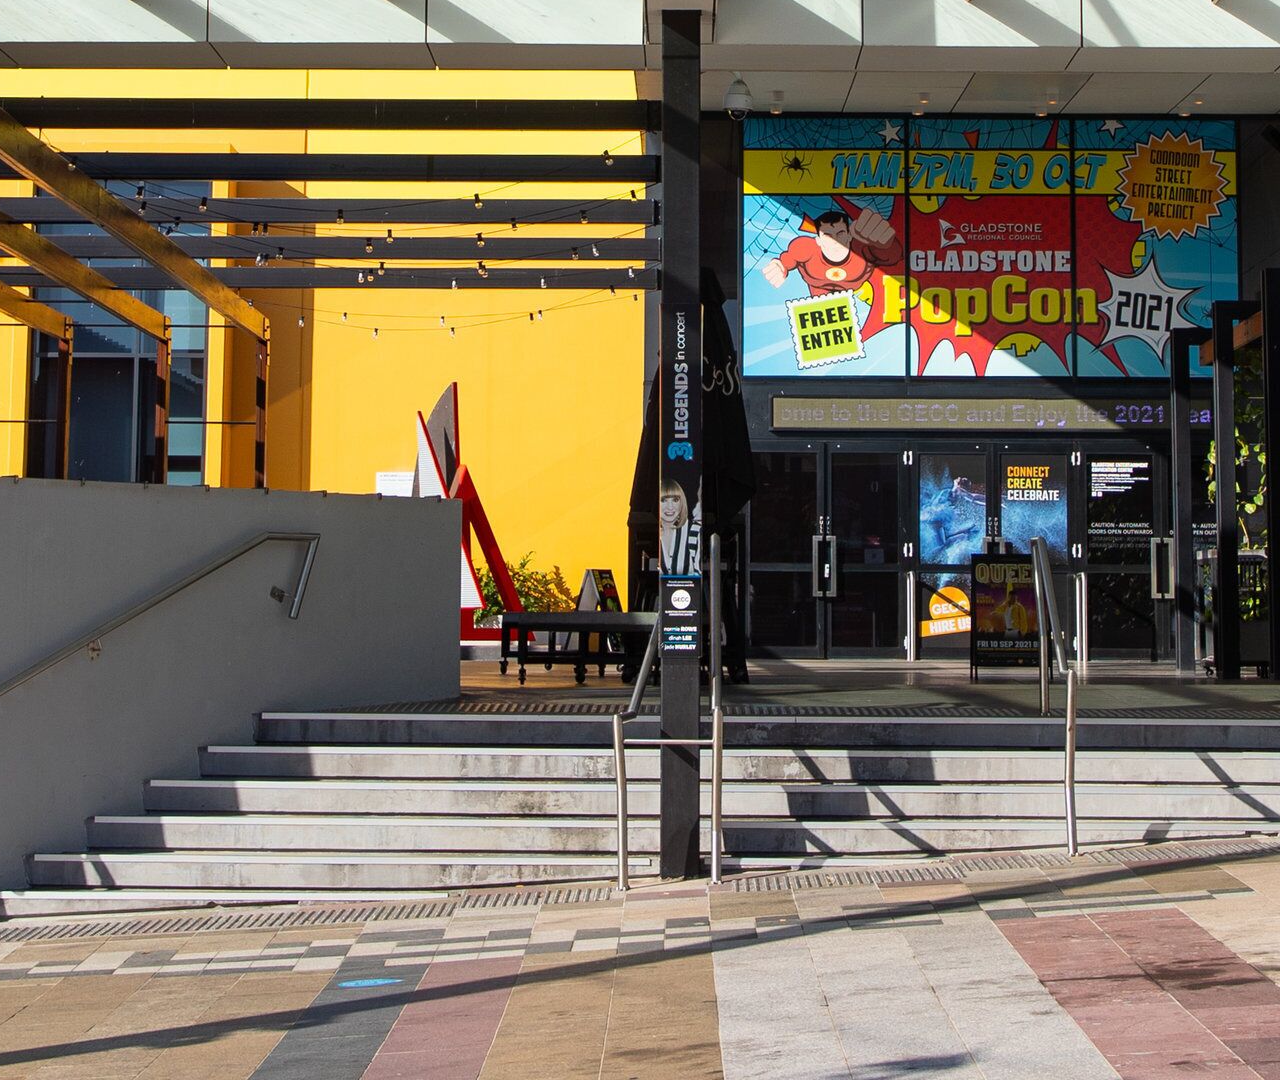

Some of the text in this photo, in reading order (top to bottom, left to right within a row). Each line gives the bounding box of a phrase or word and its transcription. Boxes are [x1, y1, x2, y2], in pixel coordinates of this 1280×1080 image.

[1150, 149, 1200, 168] GOONDOON
[989, 152, 1035, 189] 30
[1043, 153, 1107, 189] OCT
[1155, 167, 1192, 185] STREET
[1131, 183, 1213, 204] ENTERTAINMENT
[1147, 202, 1195, 220] PRECINCT
[960, 223, 1043, 234] GLADSTONE
[909, 250, 1071, 272] GLADSTONE
[882, 274, 1099, 336] PopCon
[1115, 290, 1174, 332] 2021
[799, 305, 850, 330] FREE
[675, 311, 685, 350] concert
[801, 326, 853, 351] ENTRY
[675, 351, 685, 361] in
[674, 362, 689, 439] LEGENDS
[831, 403, 852, 422] to
[856, 403, 891, 422] the
[897, 403, 959, 422] GECC
[966, 405, 1006, 423] and
[1012, 404, 1068, 427] Enjoy
[1076, 404, 1109, 424] the
[1115, 404, 1165, 424] 2021
[1007, 466, 1049, 478] CONNECT
[1007, 478, 1043, 489] CREATE
[1007, 489, 1060, 501] CELEBRATE
[929, 617, 971, 634] HIRE US
[977, 640, 989, 648] FRI
[989, 640, 998, 648] 10
[999, 640, 1014, 648] SEP
[1014, 640, 1032, 648] 2021
